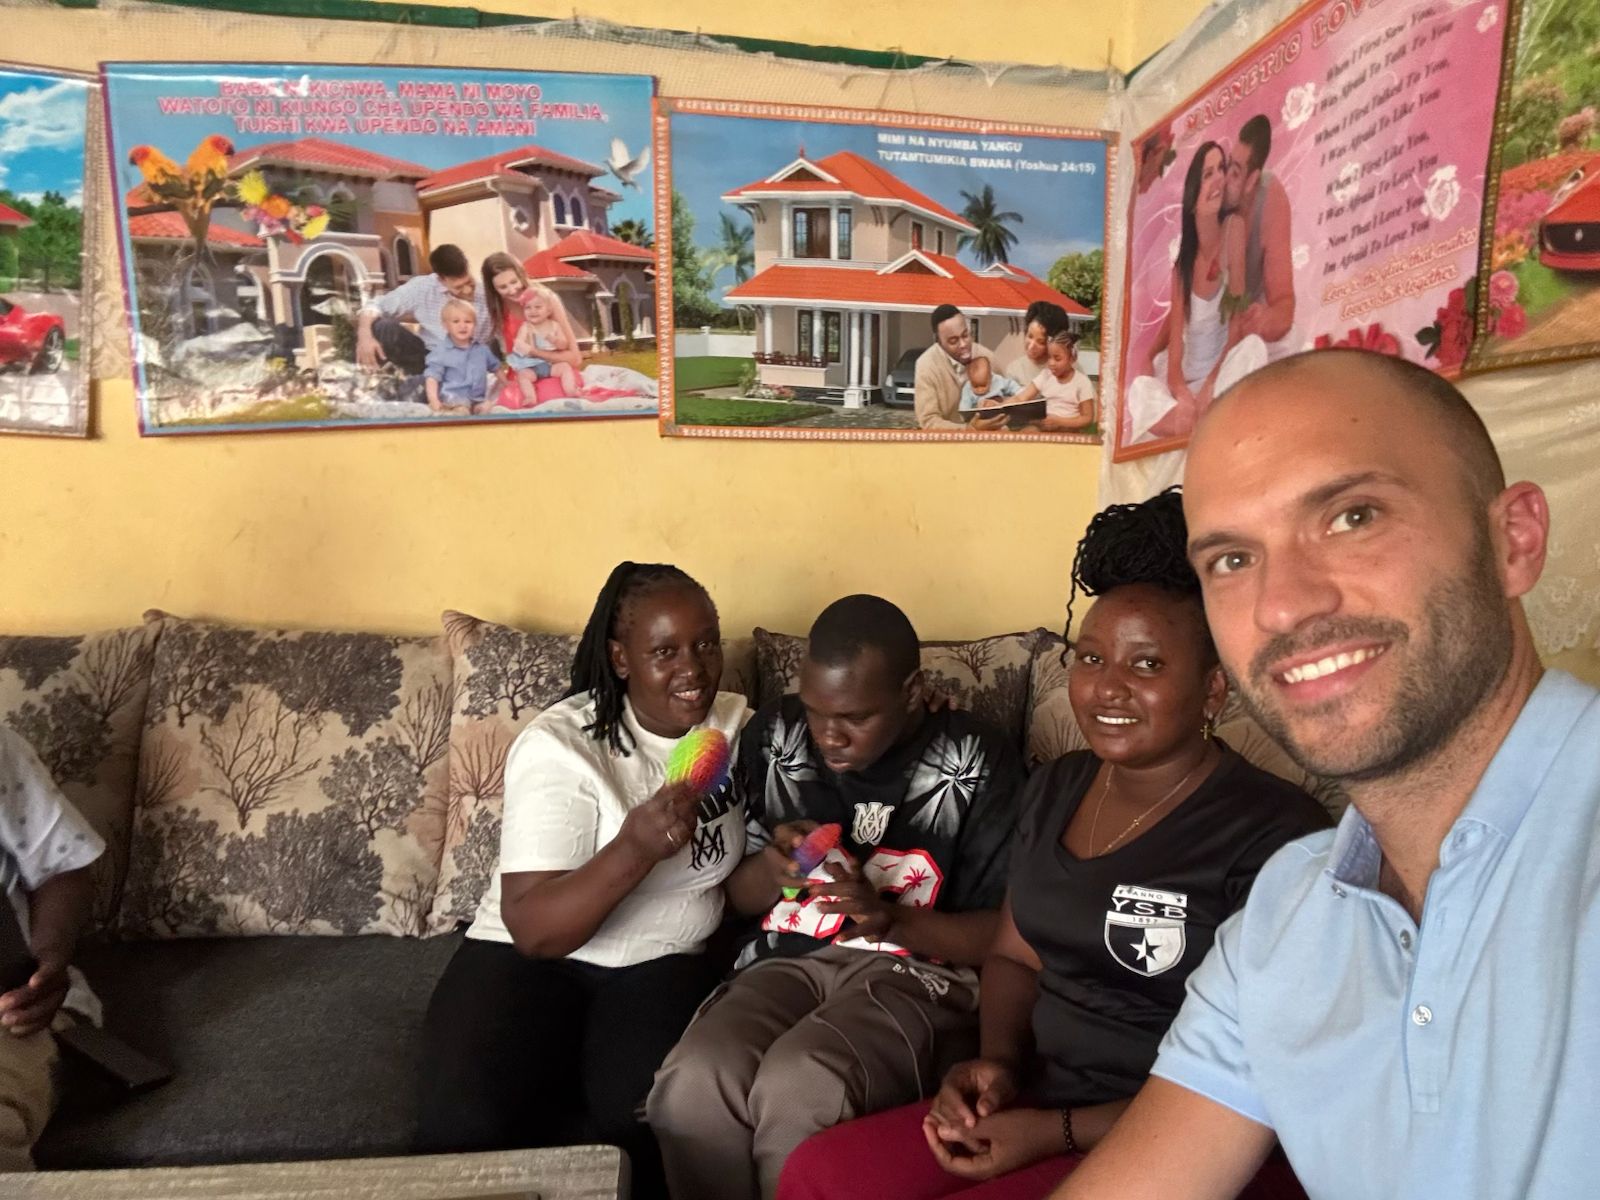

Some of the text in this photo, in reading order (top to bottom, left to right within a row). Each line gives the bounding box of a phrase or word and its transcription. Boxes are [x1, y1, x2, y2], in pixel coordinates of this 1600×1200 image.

[1326, 60, 1349, 82] When
[1358, 36, 1382, 59] First
[1384, 24, 1406, 42] Saw
[1320, 94, 1338, 111] Was
[1341, 75, 1366, 98] Afraid
[1369, 62, 1381, 79] To
[1384, 45, 1407, 67] Talk
[1412, 35, 1427, 51] To
[157, 97, 249, 115] WATOTO
[253, 98, 274, 114] NI
[279, 98, 358, 115] KIUNGO
[362, 99, 406, 116] CHA
[410, 101, 490, 118] UPENDO
[494, 102, 524, 118] WA
[399, 82, 456, 98] MAMA
[462, 83, 482, 99] NI
[485, 84, 543, 101] MOYO
[233, 115, 537, 136] TUISHI KWA UPENDO NA AMANI
[1314, 125, 1340, 146] When
[1349, 103, 1369, 125] First
[1371, 80, 1403, 110] Talked
[1406, 72, 1421, 88] To
[1329, 145, 1347, 161] Was
[1350, 123, 1377, 149] Afraid
[1379, 116, 1390, 131] To
[1393, 103, 1415, 123] Like
[1419, 88, 1441, 107] You
[878, 132, 1023, 153] MIMI NA NYUMBA YANGU
[969, 158, 1012, 170] BWANA
[1326, 175, 1351, 195] When
[1361, 156, 1382, 177] First
[1384, 143, 1404, 163] Like
[1326, 204, 1345, 221] Was
[1348, 186, 1375, 212] Afraid
[1378, 179, 1390, 195] To
[1418, 154, 1439, 173] You
[1327, 234, 1346, 249] Now
[1350, 221, 1370, 241] That
[1379, 205, 1402, 225] Love
[1340, 244, 1368, 271] Afraid
[1370, 241, 1382, 256] To
[1410, 220, 1430, 237] You
[1111, 897, 1187, 919] YSB
[1132, 890, 1164, 900] ANNO
[1132, 916, 1158, 924] 1897
